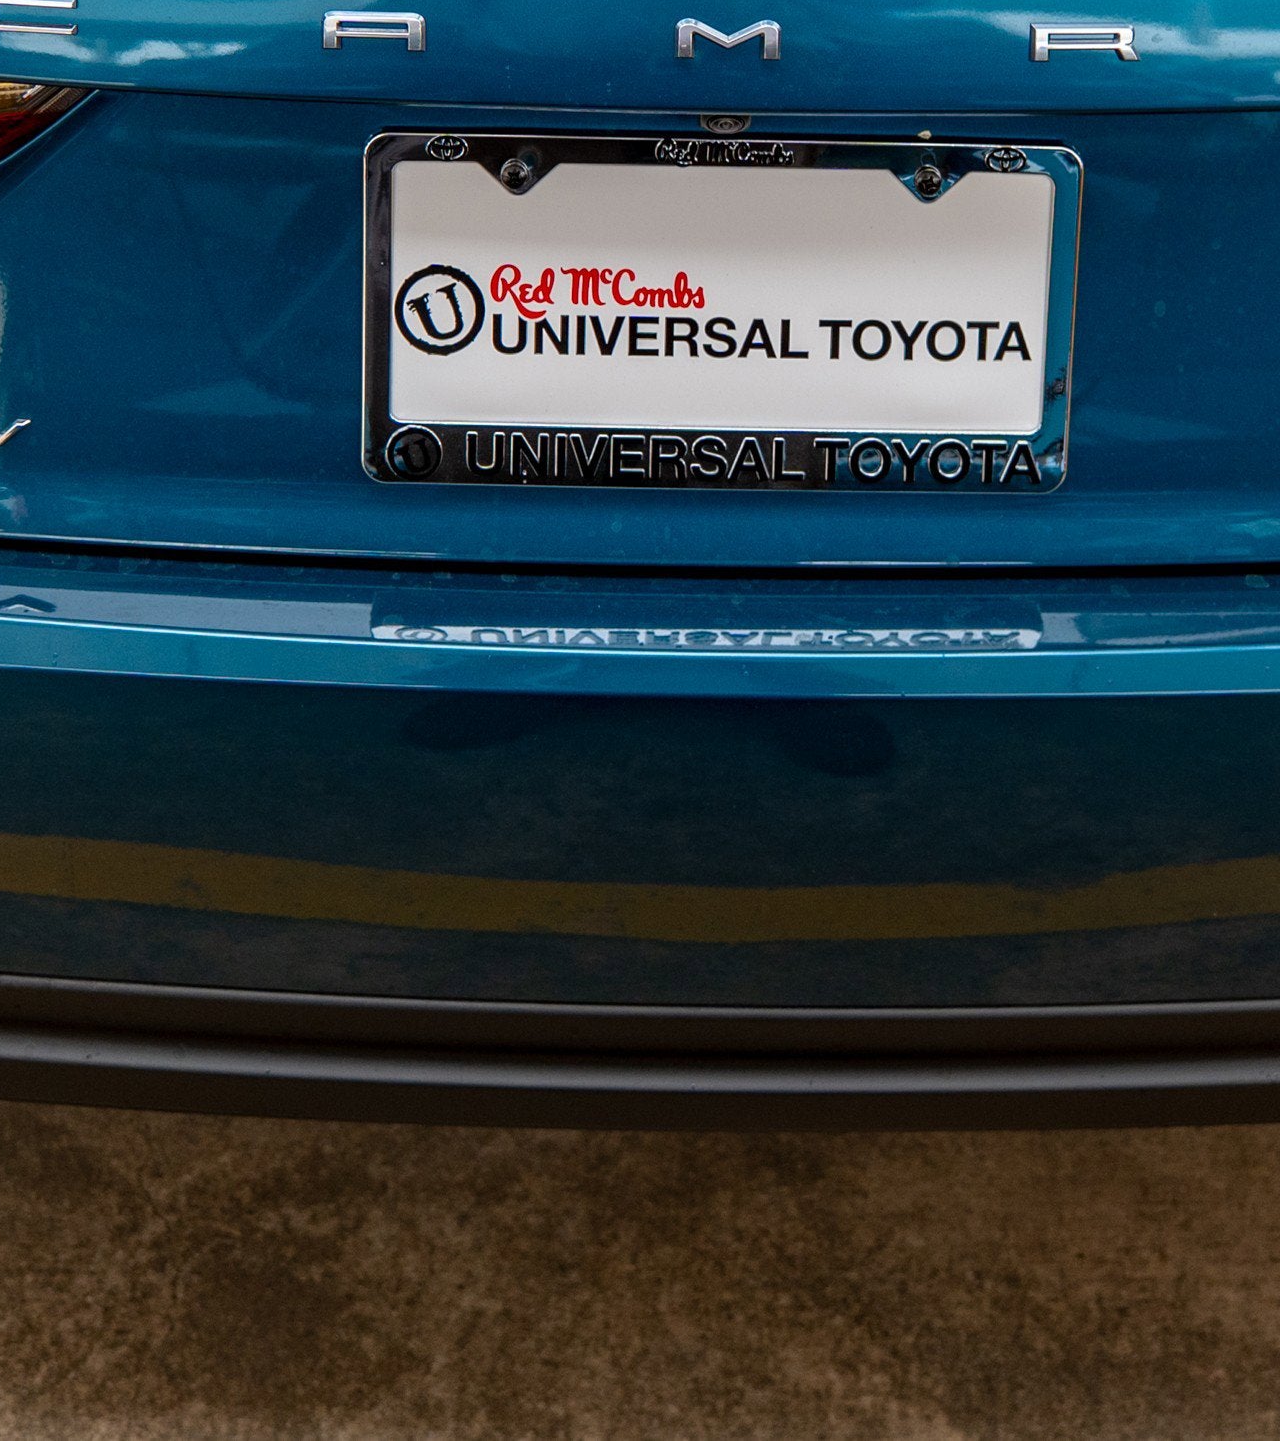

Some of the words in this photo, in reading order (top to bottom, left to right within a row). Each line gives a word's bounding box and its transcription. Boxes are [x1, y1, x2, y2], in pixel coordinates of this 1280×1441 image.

[490, 264, 555, 320] Red
[561, 267, 705, 309] McCombs
[491, 313, 809, 359] UNIVERSAL
[819, 318, 1032, 362] TOYOTA
[465, 429, 807, 482] UNIVERSAL
[814, 436, 1043, 486] TOYOTA
